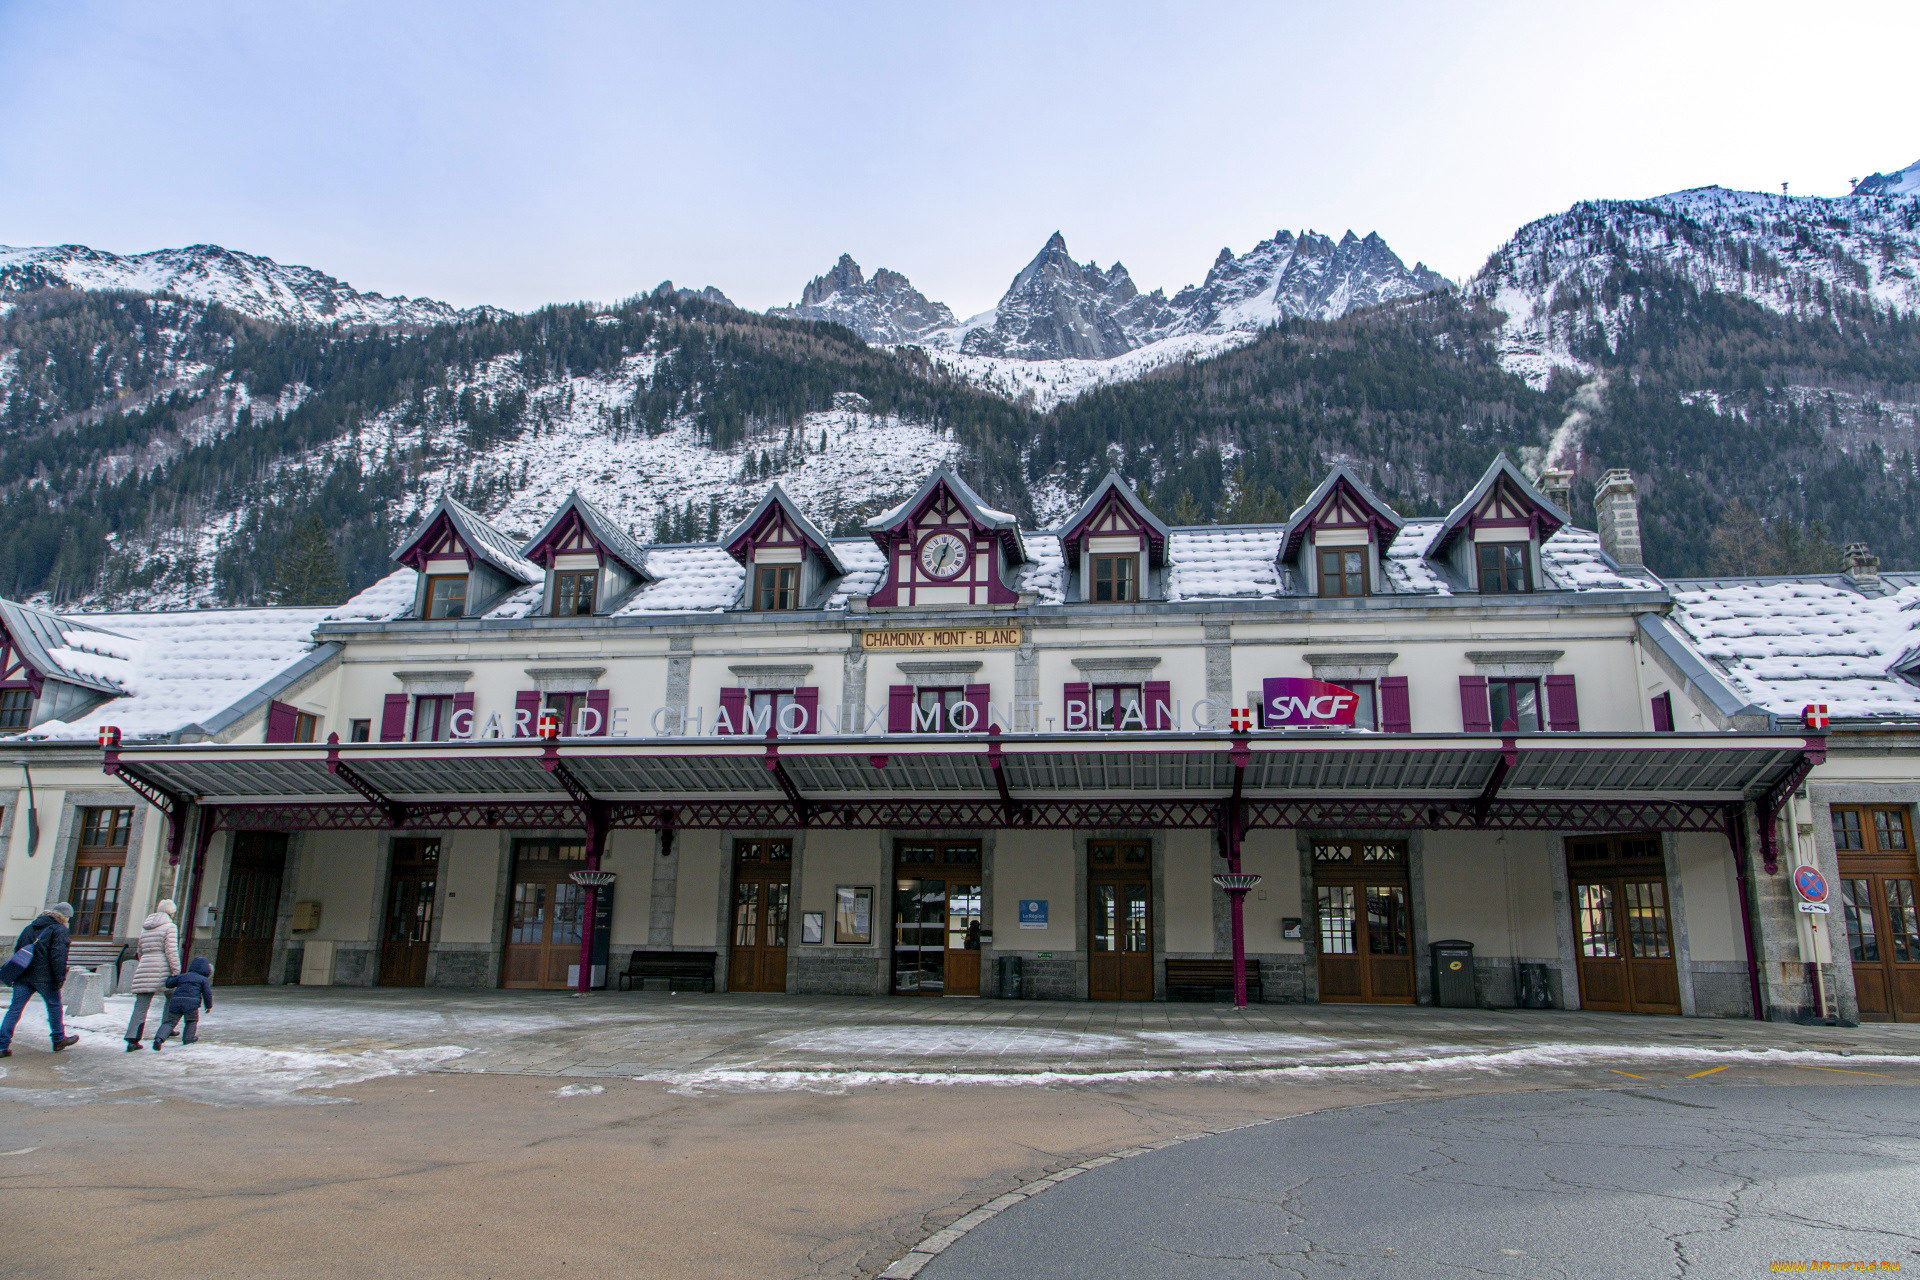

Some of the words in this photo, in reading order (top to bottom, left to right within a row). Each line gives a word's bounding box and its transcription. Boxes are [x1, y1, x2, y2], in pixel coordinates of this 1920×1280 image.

[865, 632, 925, 647] CHAMONIX
[934, 631, 966, 645] MONT
[975, 630, 1017, 645] BLANC
[577, 707, 629, 735] DE
[650, 703, 888, 734] CHAMONIX
[1268, 695, 1353, 720] SNCF
